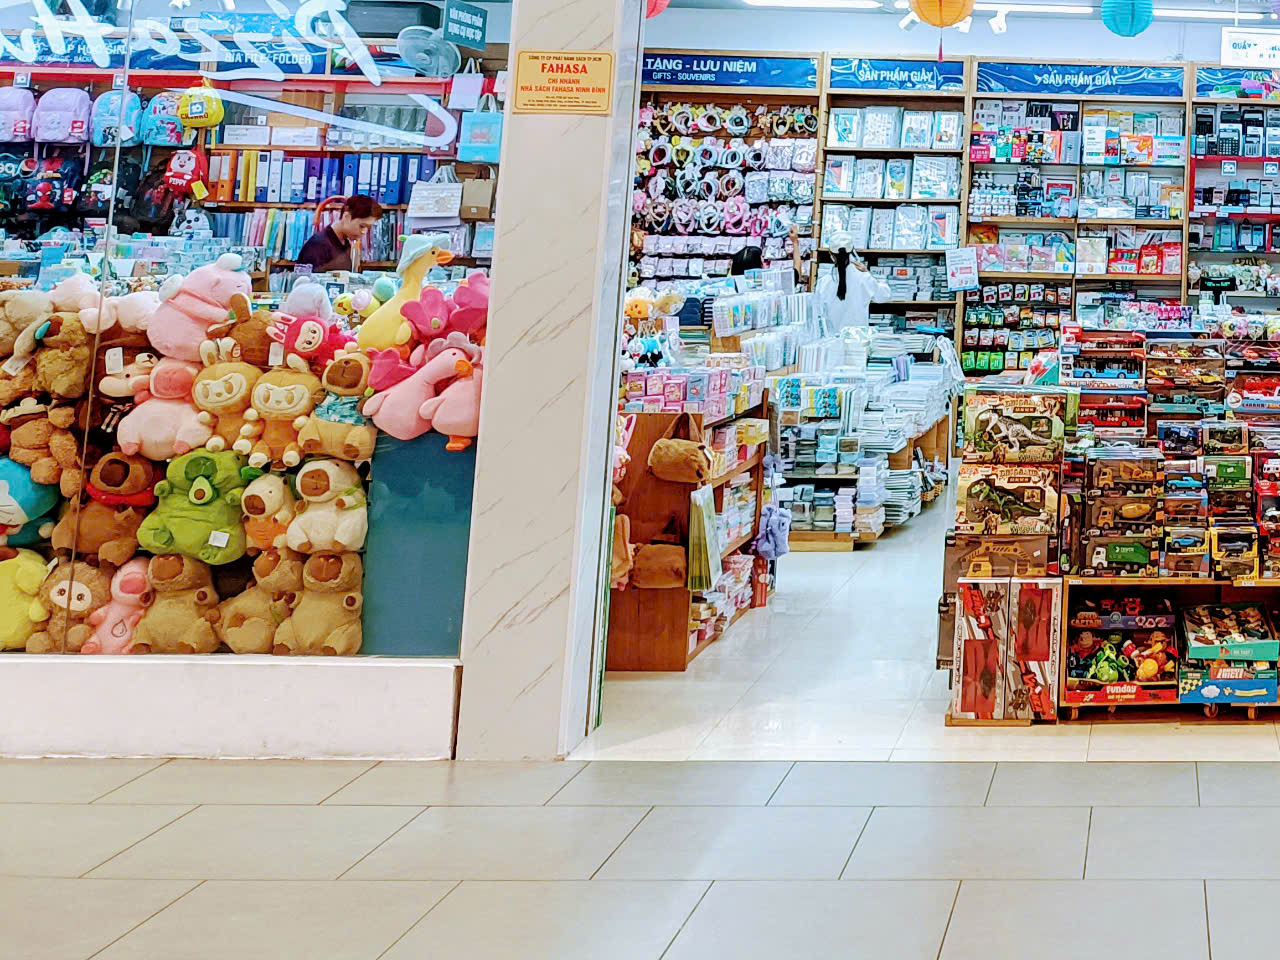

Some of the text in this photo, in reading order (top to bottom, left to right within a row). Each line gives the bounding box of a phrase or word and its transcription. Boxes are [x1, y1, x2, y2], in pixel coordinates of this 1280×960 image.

[541, 62, 588, 74] FAHASA
[723, 59, 757, 73] NIỆM
[653, 72, 671, 80] GIFTS
